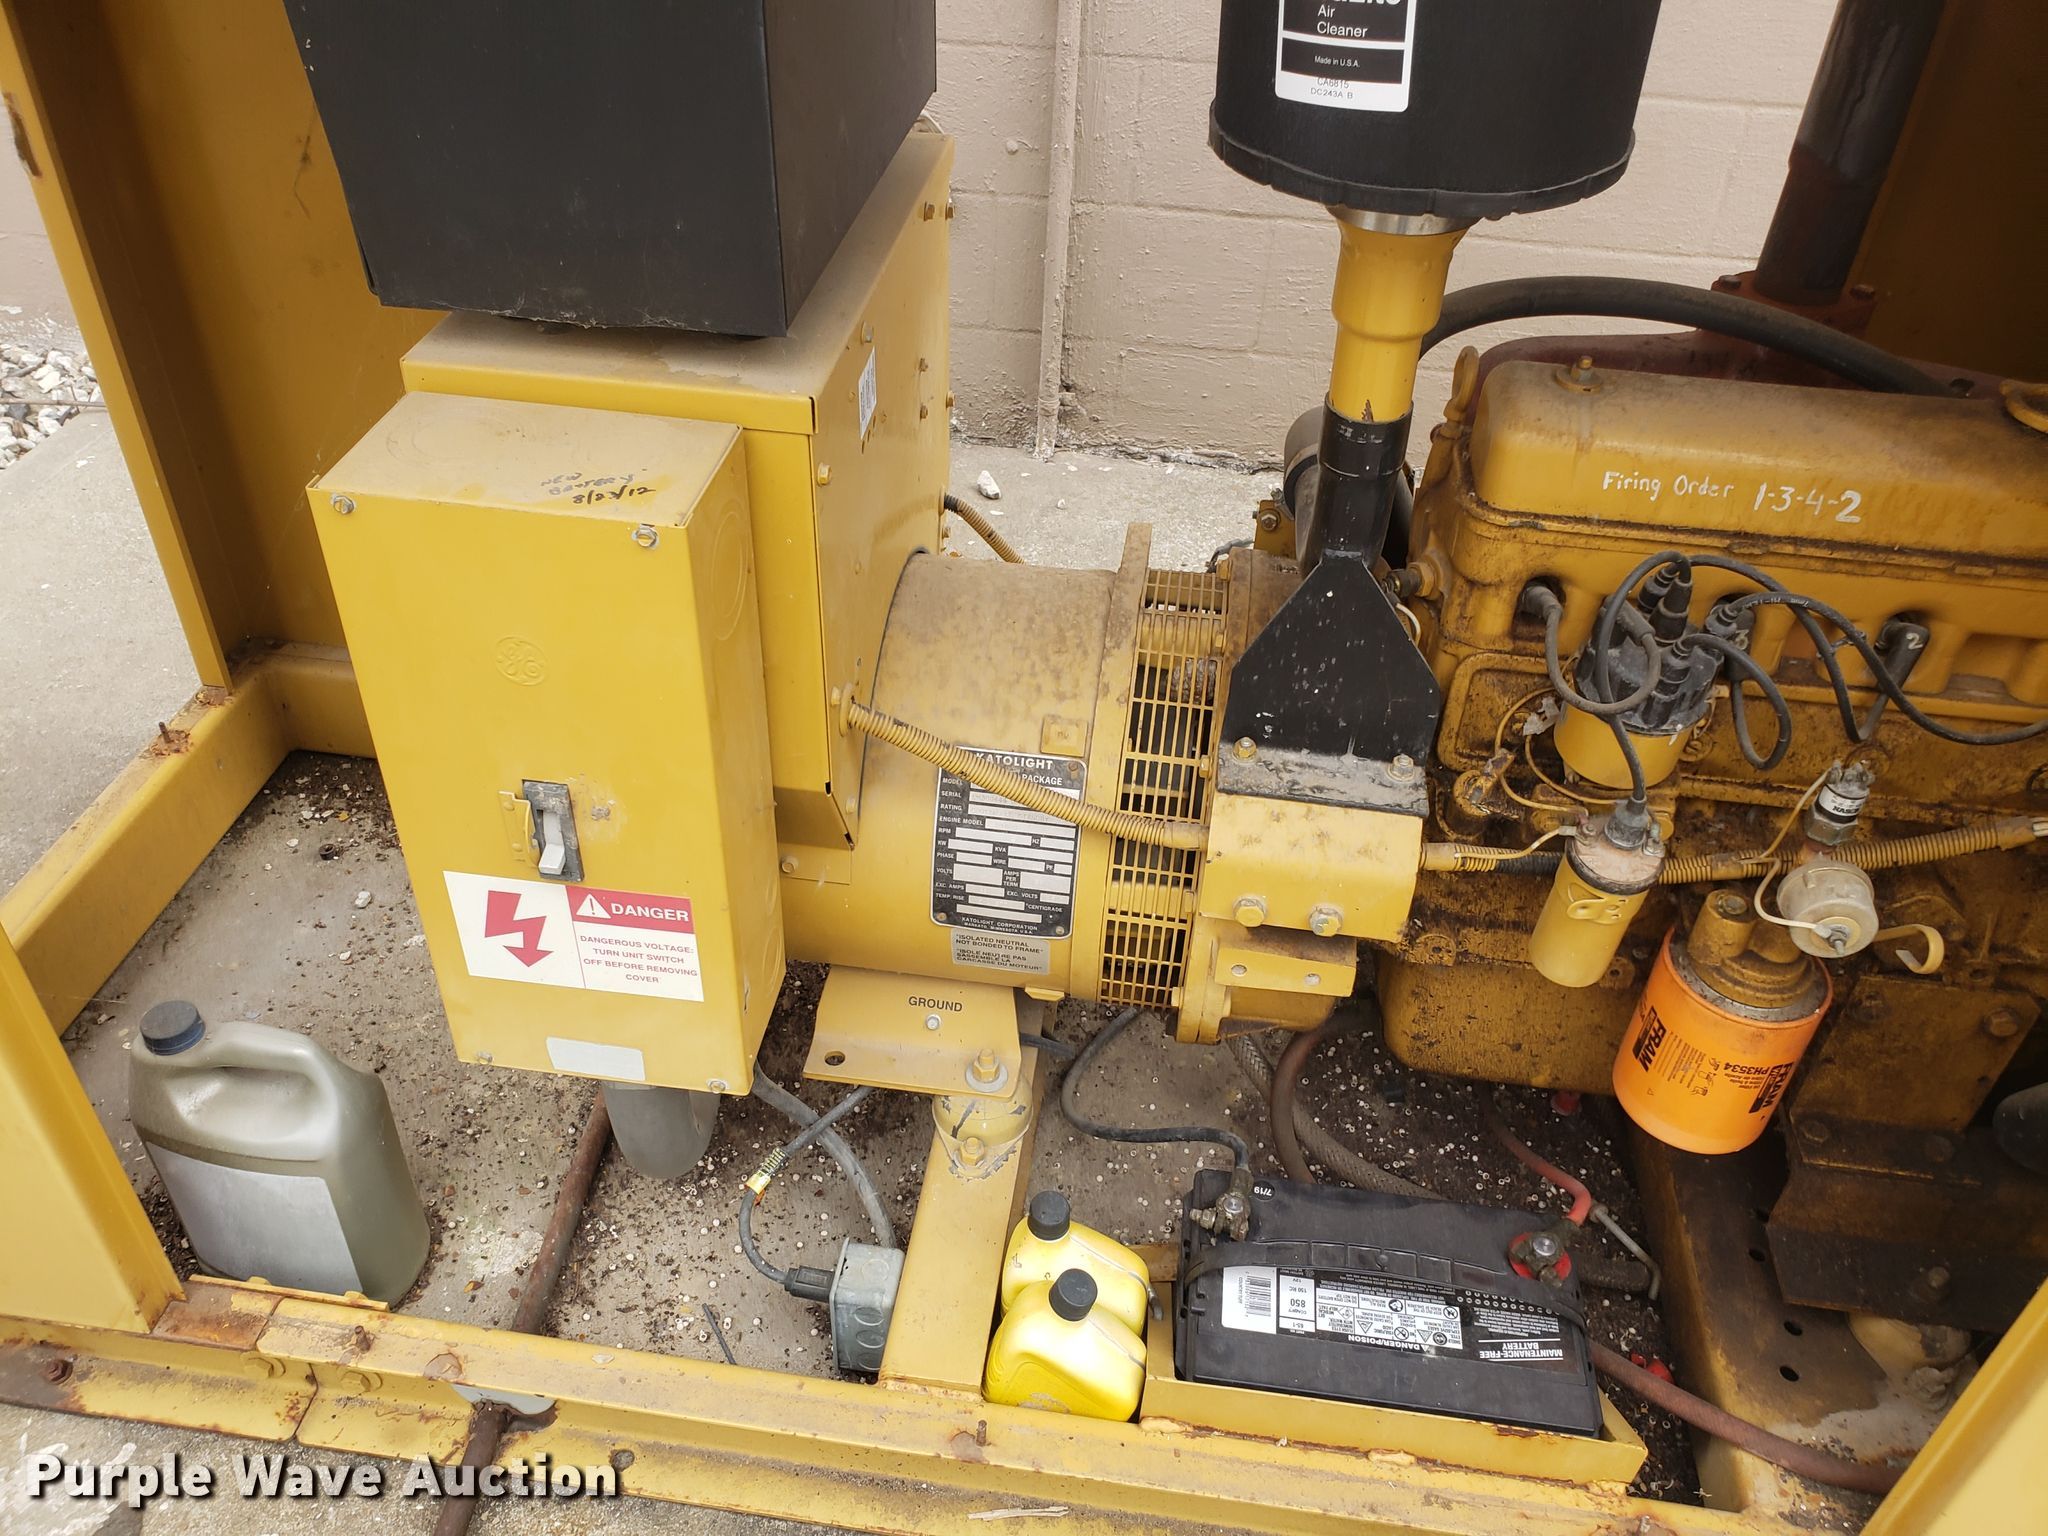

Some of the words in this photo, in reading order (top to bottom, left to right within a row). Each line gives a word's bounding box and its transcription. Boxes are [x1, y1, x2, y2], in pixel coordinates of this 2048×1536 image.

[1317, 4, 1336, 18] Air
[1316, 21, 1368, 38] Cleaner
[1314, 56, 1332, 65] Made
[1332, 57, 1338, 66] in
[1340, 58, 1360, 68] U.S.A.
[1602, 471, 1661, 502] Firing
[1673, 474, 1735, 498] Order
[1753, 482, 1862, 524] 1-3-4-2
[1906, 632, 1925, 650] 2
[1022, 773, 1063, 786] PACKAGE
[940, 803, 962, 811] RATING
[962, 818, 984, 826] MODEL
[610, 902, 690, 922] DANGER
[962, 917, 994, 926] KATOLIGHT
[996, 921, 1038, 930] CORPORATION
[580, 934, 642, 949] DANGEROUS
[972, 941, 1003, 949] BONDED
[996, 938, 1030, 947] NEUTRAL
[592, 948, 620, 959] TURN
[622, 951, 644, 961] UNIT
[646, 953, 685, 964] SWITCH
[956, 956, 996, 965] CARCASSE
[583, 958, 602, 967] OFF
[605, 960, 644, 972] BEFORE
[646, 964, 698, 977] REMOVING
[625, 974, 660, 984] COVER
[908, 996, 962, 1012] GROUND
[1639, 1017, 1667, 1072] FRAM
[1723, 1062, 1770, 1076] PH3534
[1254, 1186, 1272, 1196] 7/19
[1290, 1298, 1306, 1308] 850
[1348, 1334, 1420, 1350] DANGER/POISON
[1502, 1342, 1539, 1351] BATTERY
[1480, 1349, 1563, 1358] MAINTENANCE-FREE
